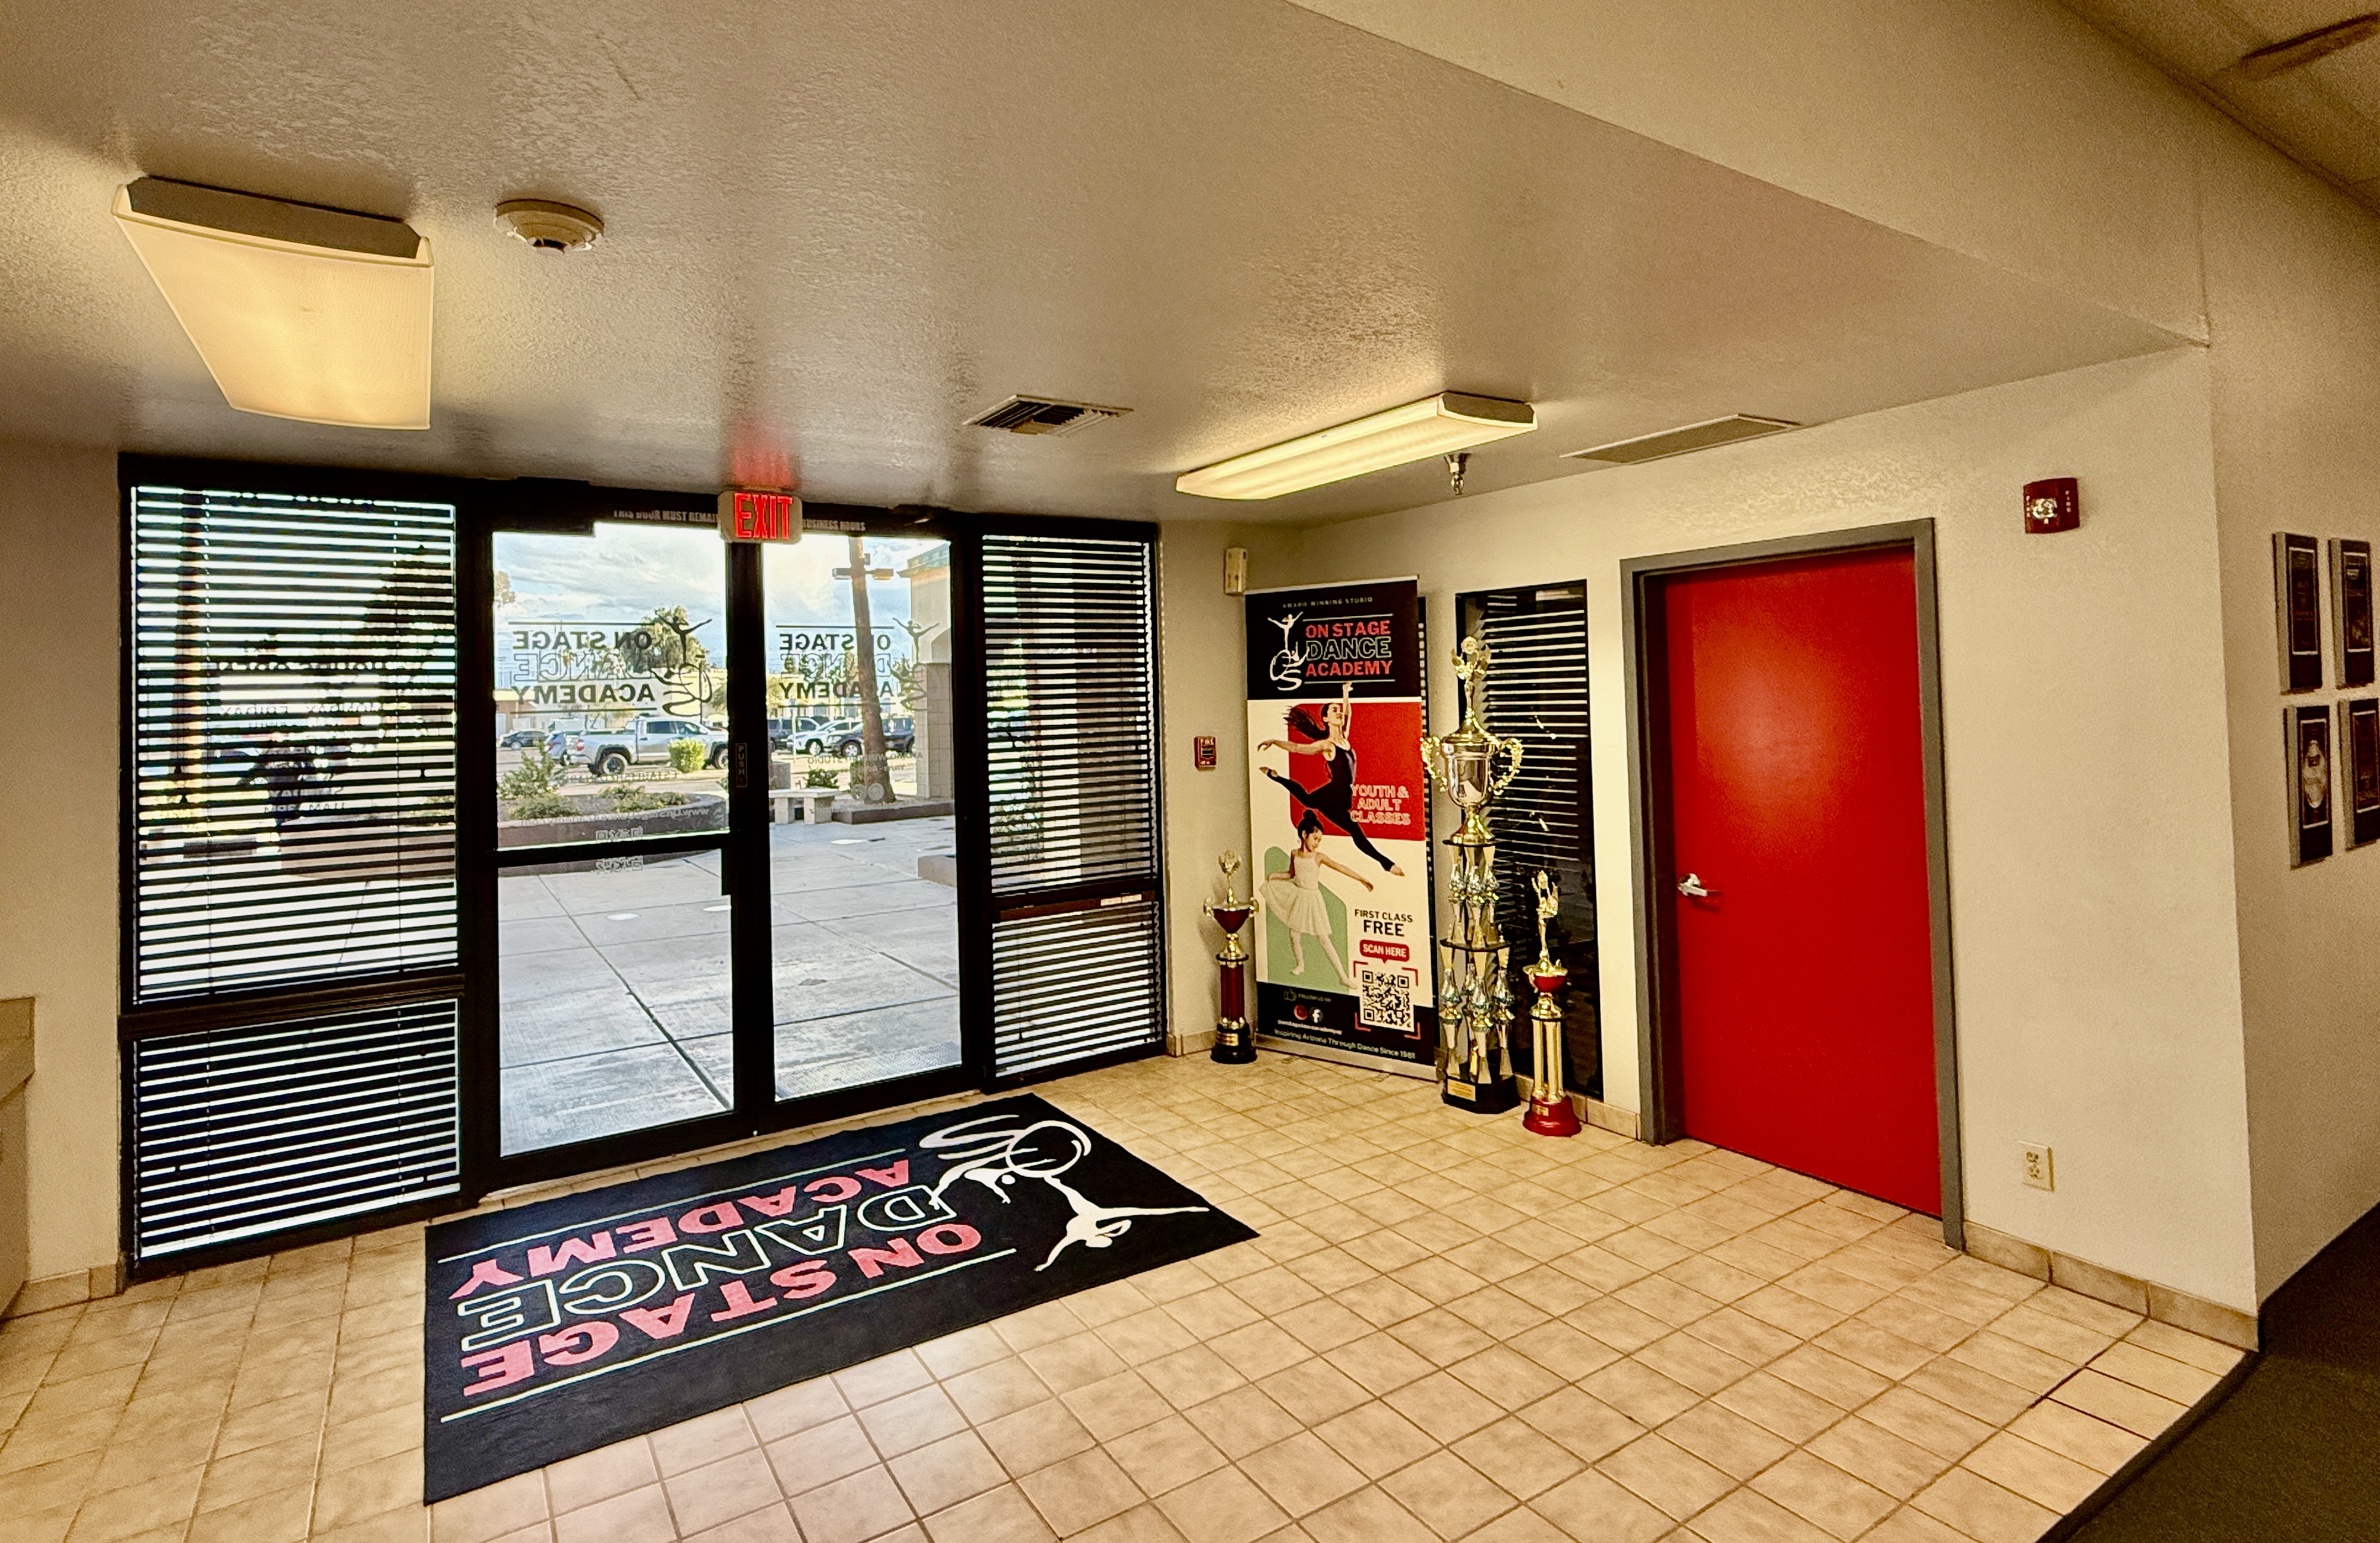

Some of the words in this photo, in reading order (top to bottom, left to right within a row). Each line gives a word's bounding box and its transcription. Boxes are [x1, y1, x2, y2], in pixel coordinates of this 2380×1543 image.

[662, 511, 687, 521] MUST
[734, 492, 793, 540] EXIT
[840, 521, 866, 532] HOURS
[1305, 624, 1328, 638] ON
[1332, 620, 1390, 637] STAGE
[1306, 637, 1391, 661] DANCE
[1305, 660, 1392, 677] ACADEMY
[1350, 784, 1395, 798] YOUTH
[1397, 785, 1409, 798] &
[1357, 798, 1402, 811] ADULT
[1350, 810, 1410, 825] CLASSES
[1354, 909, 1379, 919] FIRST
[1381, 912, 1413, 922] CLASS
[1363, 919, 1404, 937] FREE
[1362, 944, 1383, 955] SCAN
[1385, 947, 1407, 958] HERE
[1302, 1033, 1326, 1043] Arizona
[1328, 1038, 1356, 1049] Through
[1357, 1043, 1378, 1053] Dance
[1380, 1046, 1398, 1056] Since
[451, 1158, 911, 1300] ACADEMY
[855, 1223, 983, 1283] ON
[457, 1184, 957, 1353] DANCE
[460, 1258, 841, 1399] STAGE
